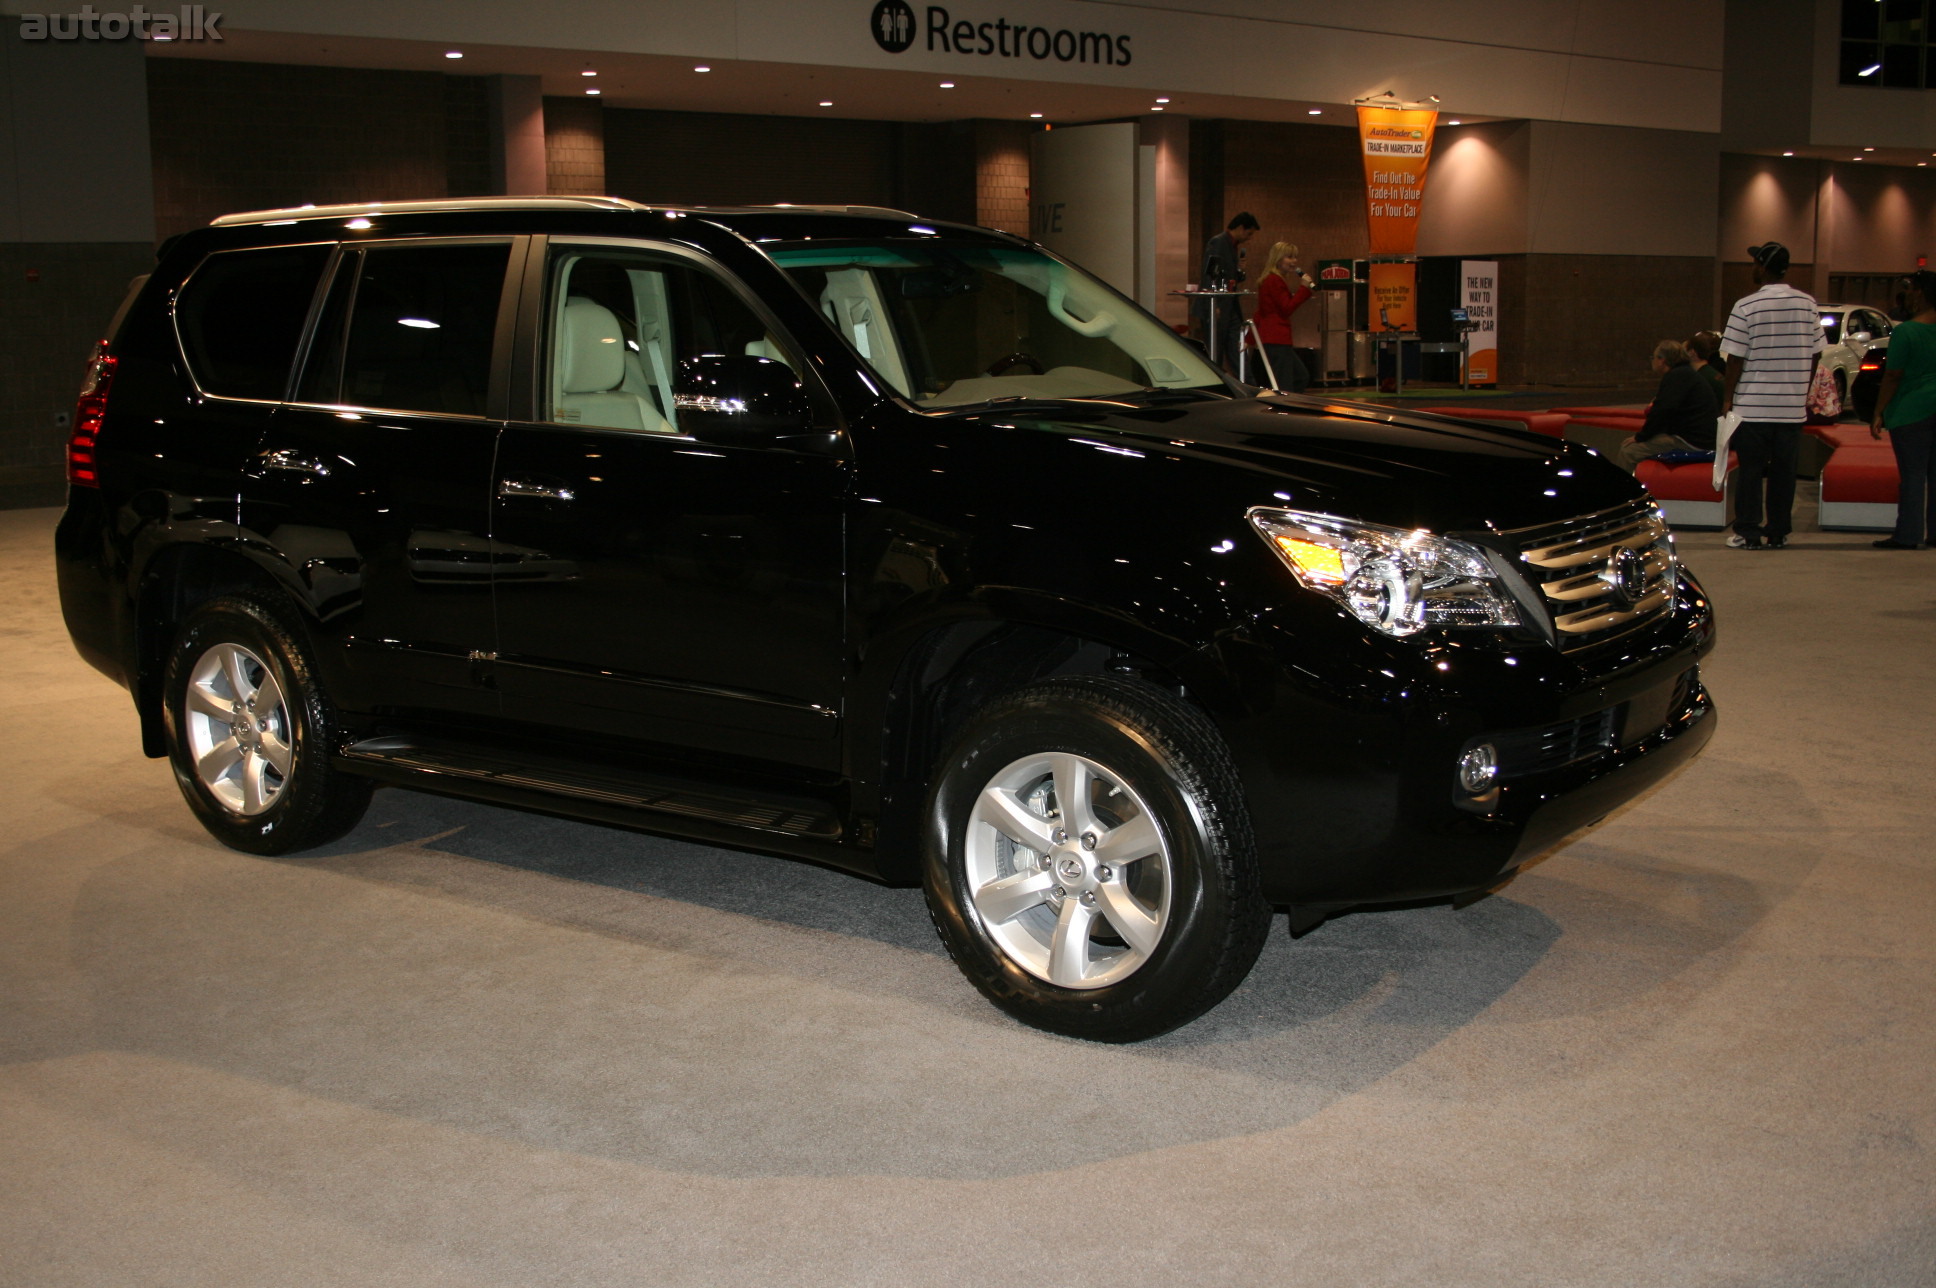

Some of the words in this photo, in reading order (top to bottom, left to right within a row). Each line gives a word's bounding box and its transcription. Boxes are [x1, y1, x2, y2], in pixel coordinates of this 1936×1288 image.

[926, 6, 1132, 67] Restrooms
[1367, 142, 1389, 153] TRADE-IN
[1390, 143, 1423, 154] MARKETPLACE
[1373, 170, 1388, 183] Find
[1389, 171, 1402, 184] Out
[1403, 172, 1416, 185] The
[1368, 185, 1398, 200] Trade-In
[1400, 186, 1421, 200] Value
[1371, 202, 1384, 217] For
[1385, 202, 1402, 217] Your
[1403, 203, 1417, 218] Car
[1467, 276, 1478, 289] THE
[1479, 277, 1493, 289] NEW
[1469, 291, 1481, 303] WAY
[1483, 292, 1491, 303] TO
[1466, 305, 1493, 318] TRADE-IN
[1482, 320, 1494, 332] CAR
